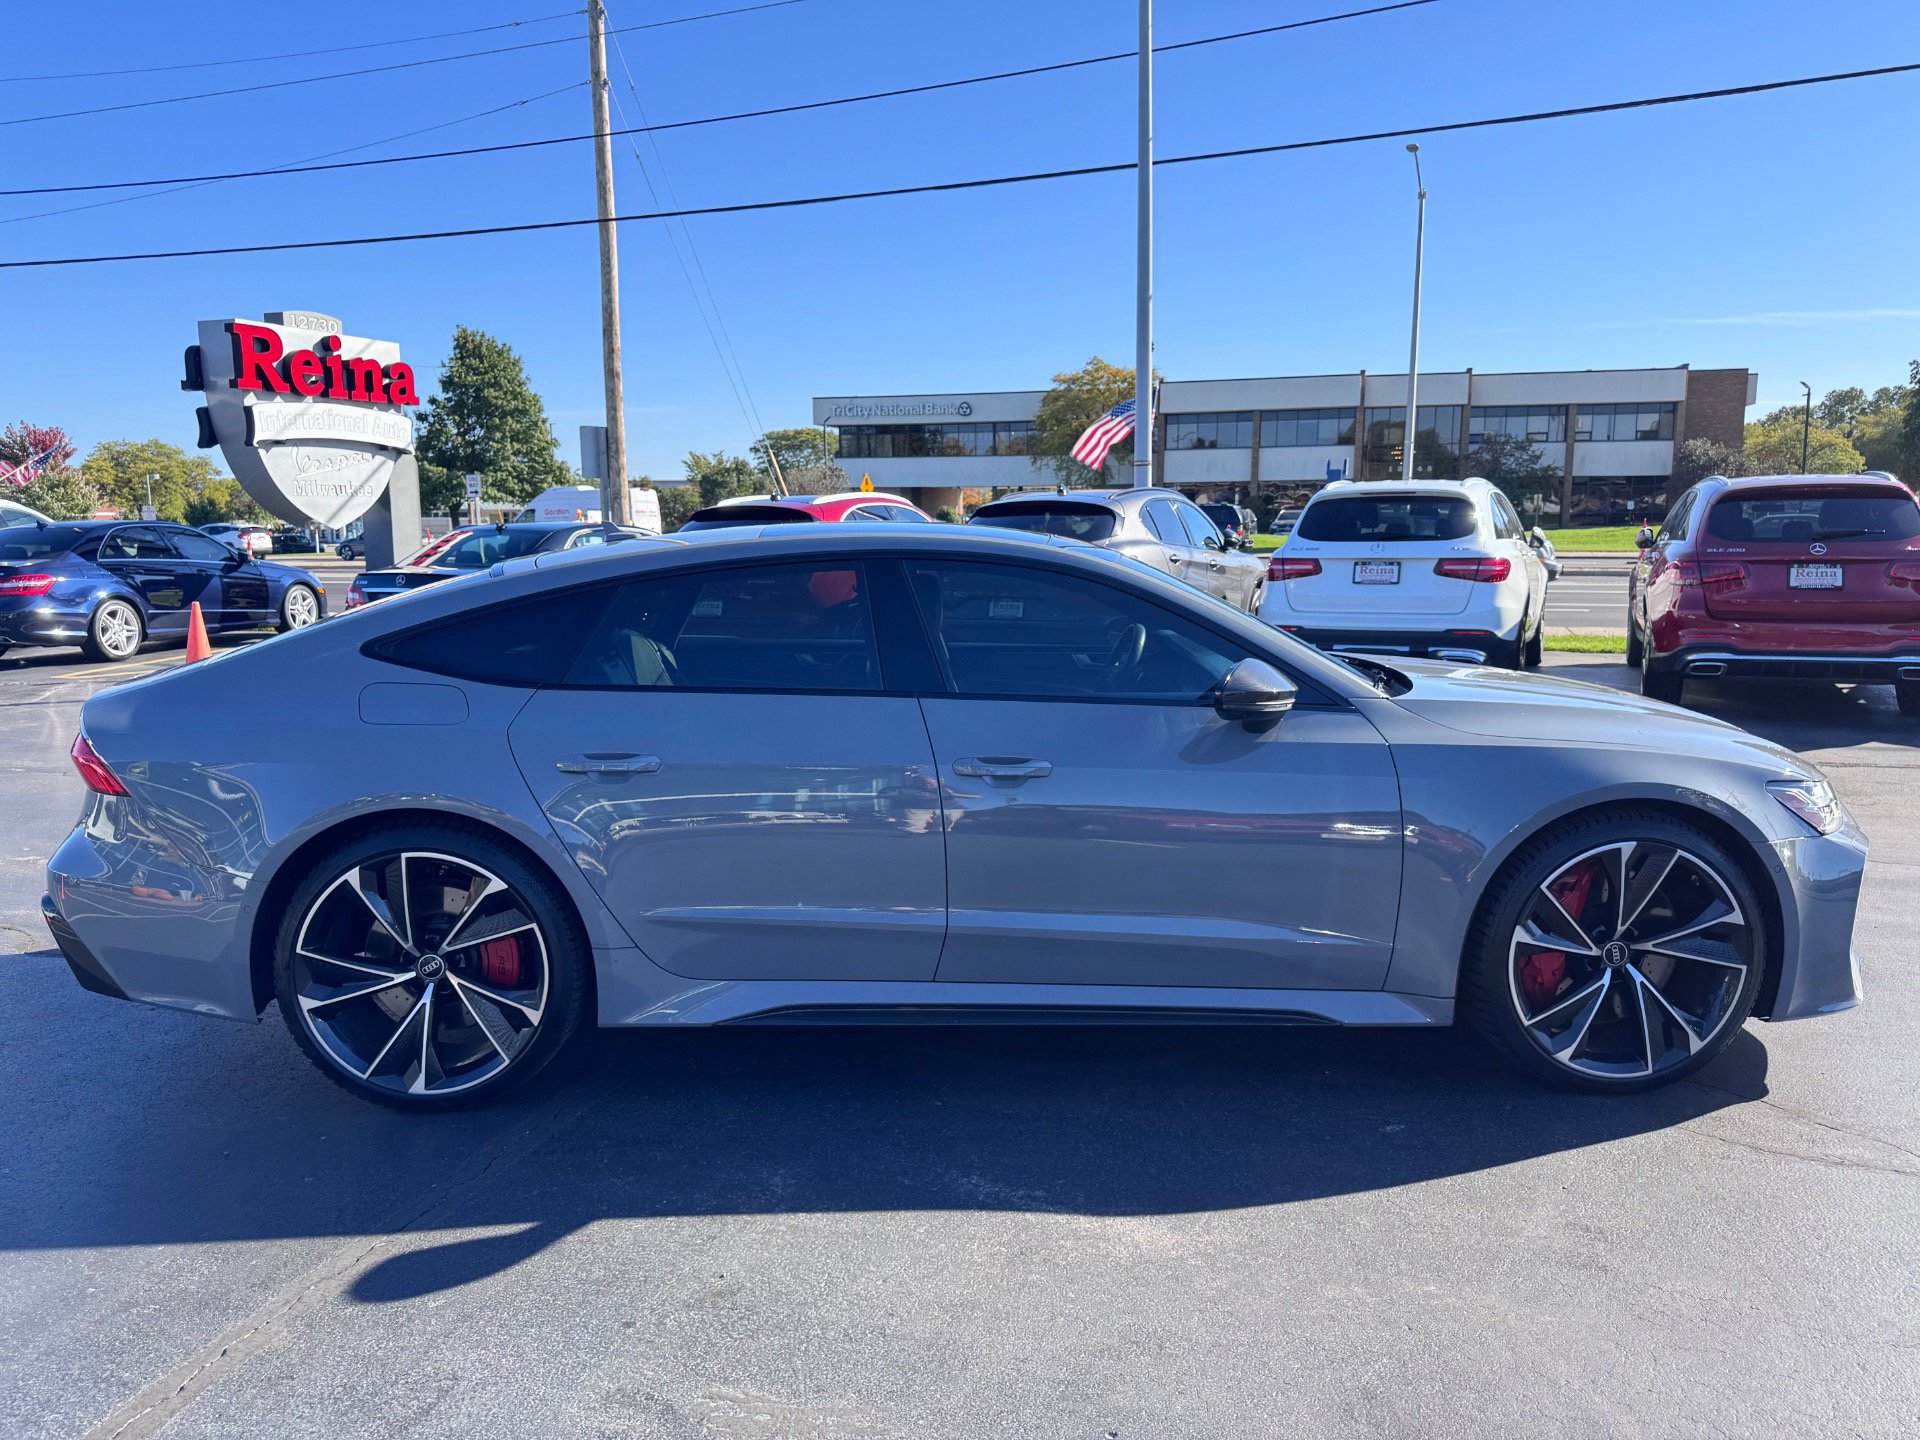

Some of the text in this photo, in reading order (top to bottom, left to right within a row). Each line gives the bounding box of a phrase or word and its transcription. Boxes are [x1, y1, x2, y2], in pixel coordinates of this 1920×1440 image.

[289, 314, 339, 333] 12730
[231, 322, 420, 406] Reina
[872, 402, 923, 417] National
[925, 403, 956, 416] Bank
[258, 408, 408, 443] International Auto
[290, 441, 371, 479] Vespa
[292, 479, 374, 497] Milwaukee
[544, 508, 570, 516] Gordon
[1360, 564, 1394, 575] Reina
[1795, 567, 1837, 577] Reina
